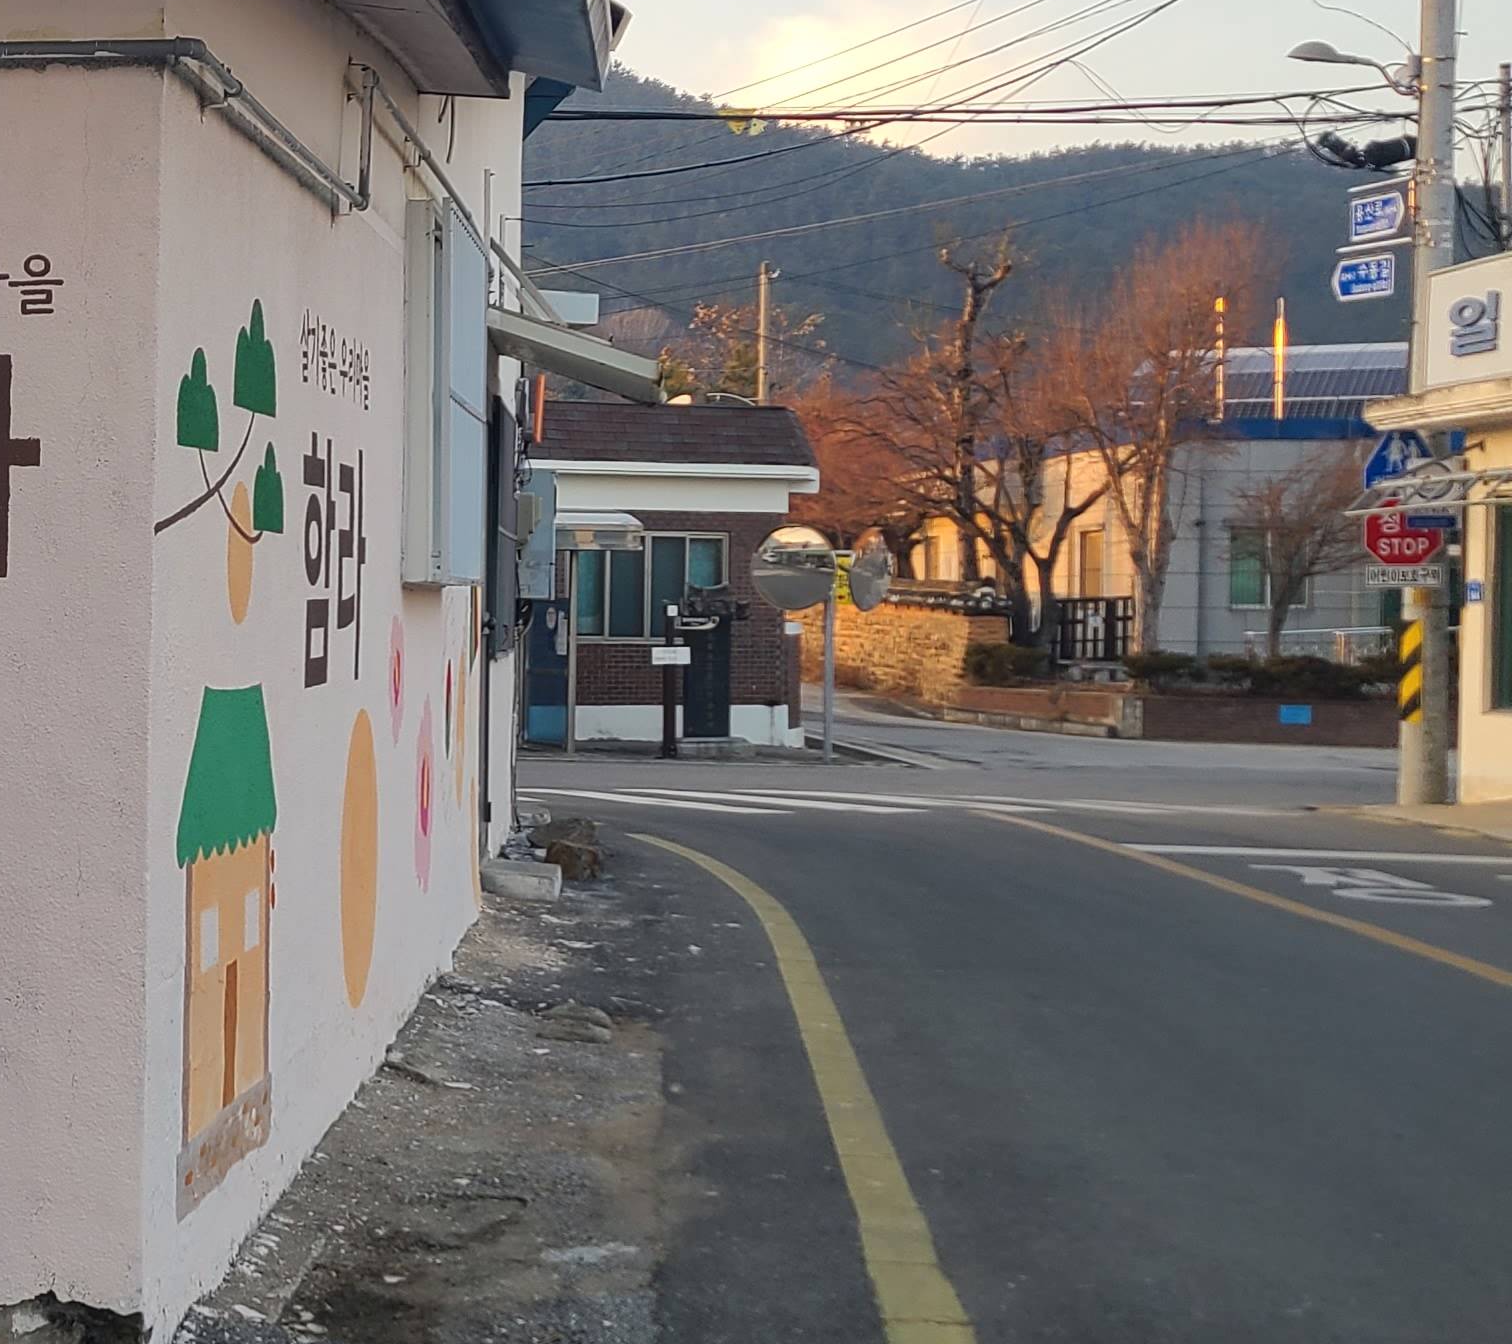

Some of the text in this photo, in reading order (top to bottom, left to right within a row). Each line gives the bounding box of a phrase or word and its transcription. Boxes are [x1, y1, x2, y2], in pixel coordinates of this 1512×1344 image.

[300, 309, 371, 411] 살기좋은 우리마을
[1449, 290, 1500, 357] 일
[303, 431, 366, 689] 함라
[1377, 537, 1430, 555] STOP
